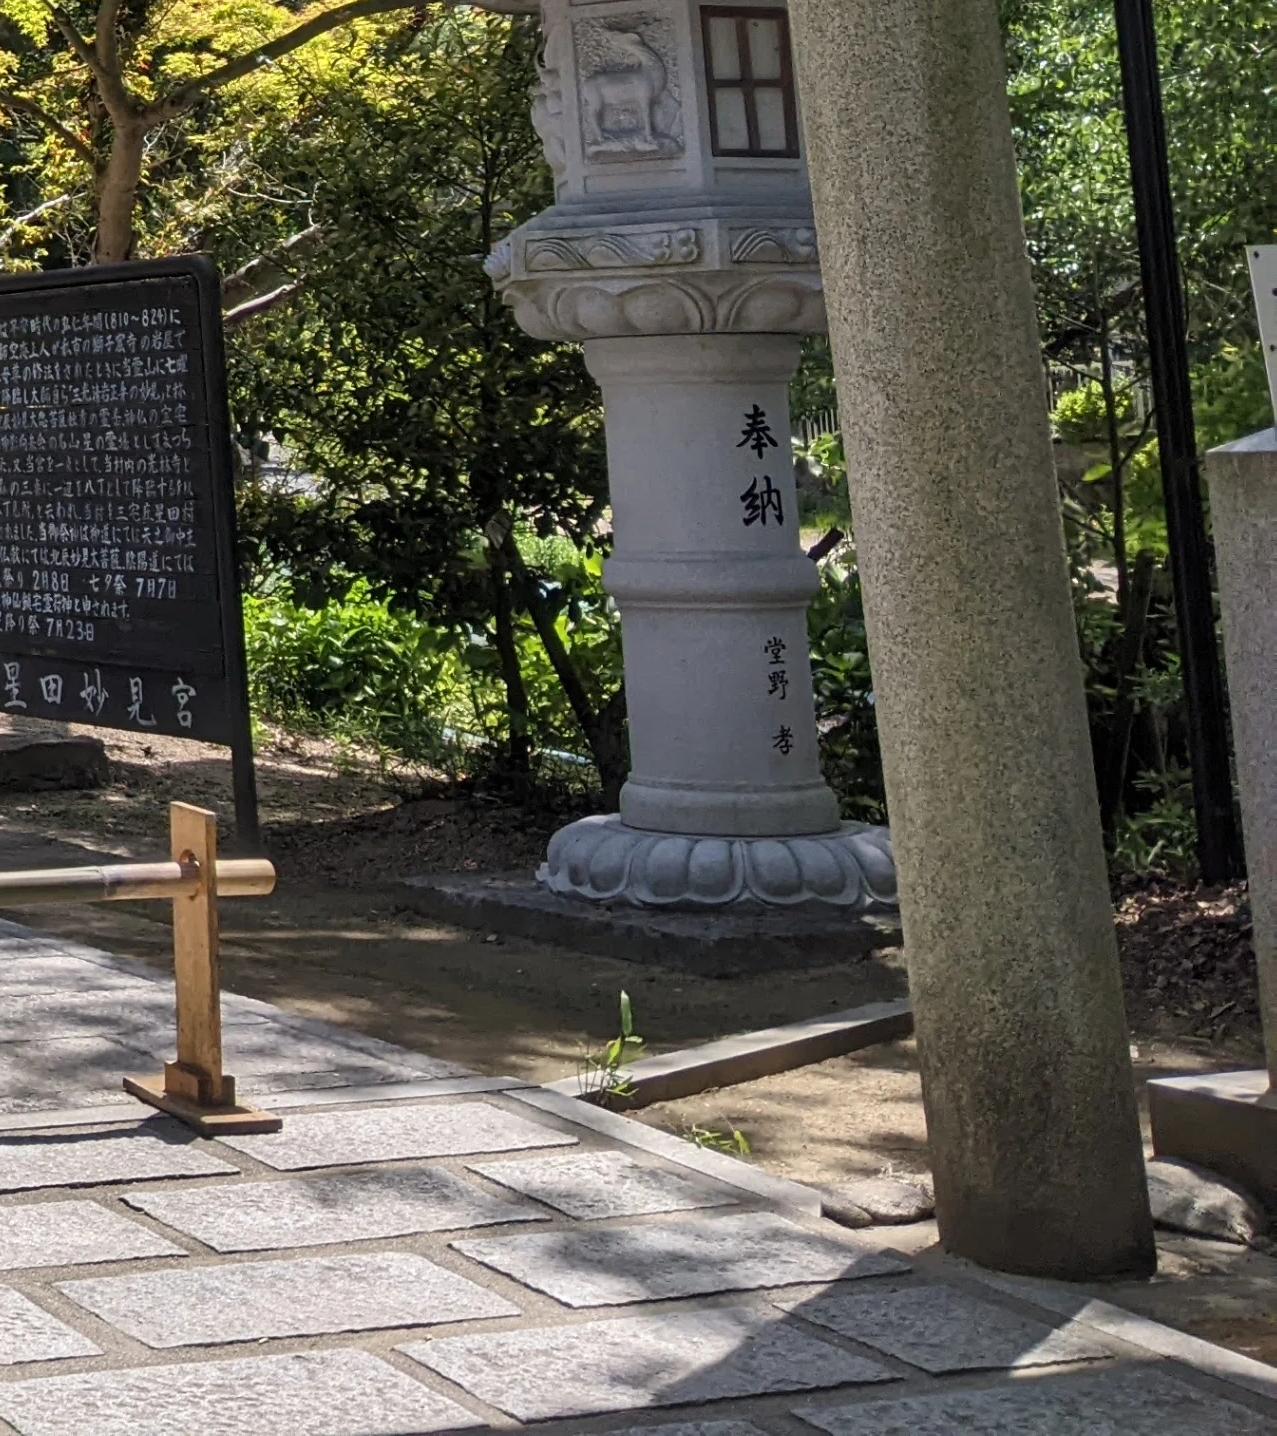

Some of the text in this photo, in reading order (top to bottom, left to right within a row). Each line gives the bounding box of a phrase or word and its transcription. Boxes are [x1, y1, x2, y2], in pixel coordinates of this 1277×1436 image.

[736, 403, 784, 527] 奉納
[136, 577, 177, 599] 7月7日
[4, 662, 196, 728] 星田妙見宮
